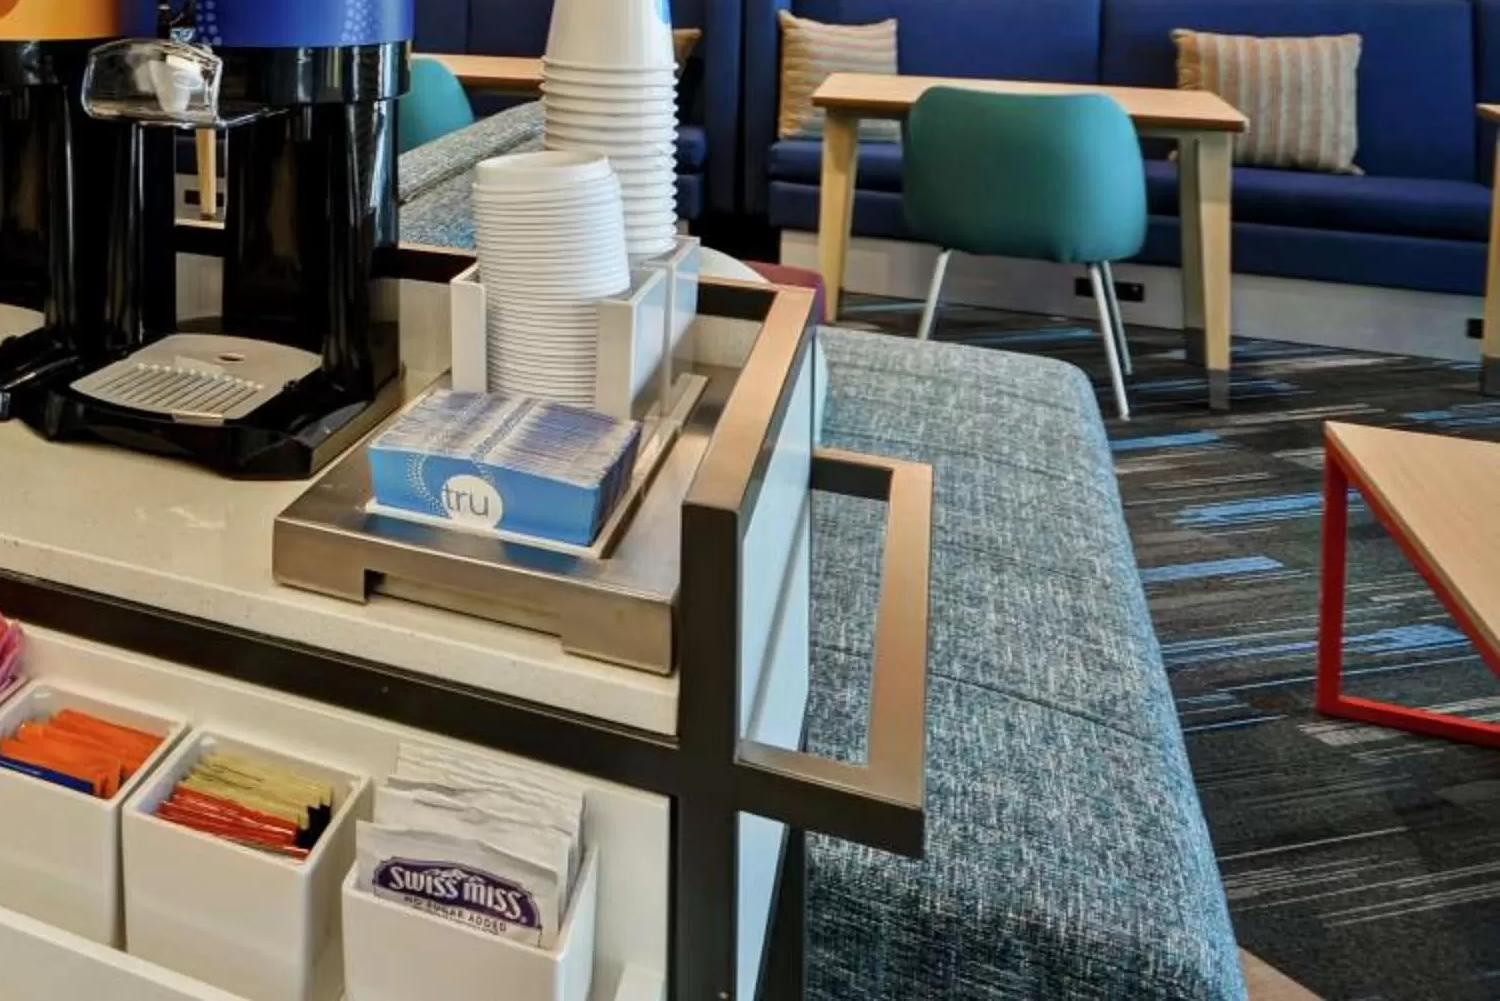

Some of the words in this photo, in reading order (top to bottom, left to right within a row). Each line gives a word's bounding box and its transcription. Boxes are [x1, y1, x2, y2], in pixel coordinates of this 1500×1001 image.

[445, 483, 489, 516] tru
[389, 866, 460, 899] SWISS
[463, 880, 523, 920] MISS
[468, 913, 507, 932] ADDED
